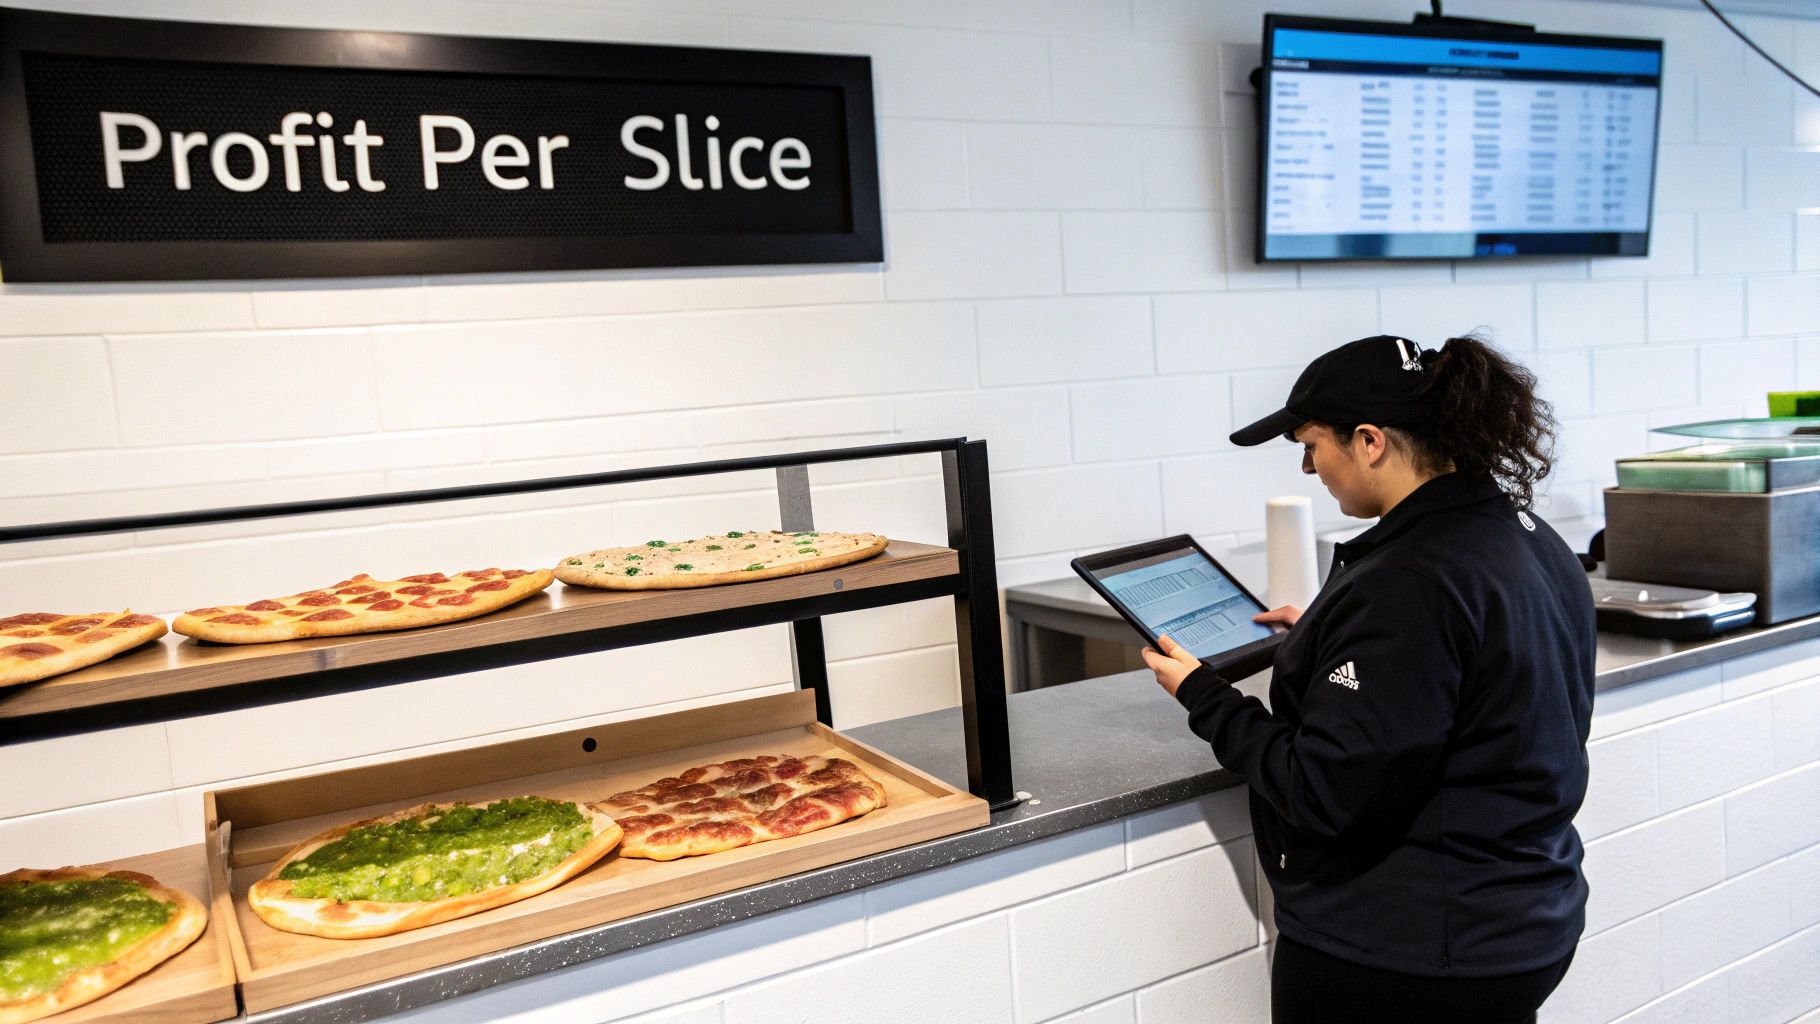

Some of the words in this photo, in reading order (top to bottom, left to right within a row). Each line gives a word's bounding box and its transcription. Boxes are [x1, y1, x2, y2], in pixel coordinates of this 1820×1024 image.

[101, 111, 386, 193] Profit
[420, 114, 570, 191] Per
[621, 113, 812, 191] Slice
